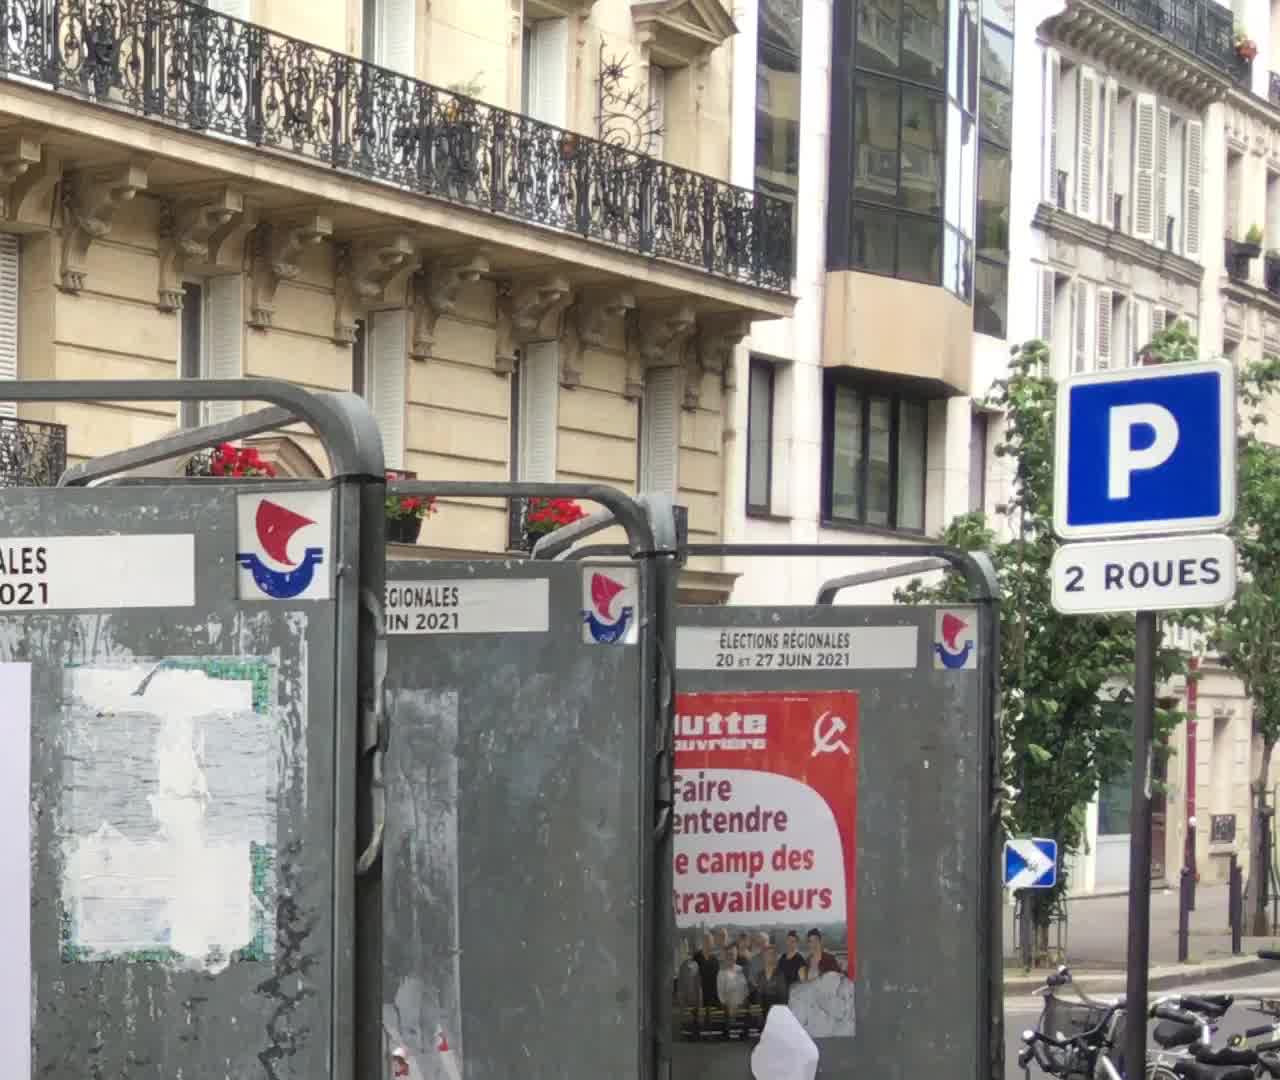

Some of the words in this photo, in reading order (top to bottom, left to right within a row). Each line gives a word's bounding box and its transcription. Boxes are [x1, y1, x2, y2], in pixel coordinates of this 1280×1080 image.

[1108, 403, 1179, 500] P
[1064, 566, 1084, 592] 2
[1104, 558, 1220, 590] ROUES
[384, 587, 458, 608] GIONALES
[385, 613, 408, 630] IN
[416, 613, 459, 630] 2021
[720, 631, 778, 649] ÉLECTIONS
[784, 630, 850, 648] RÉGIONALES
[716, 653, 734, 667] 20
[738, 658, 750, 666] ET
[755, 654, 773, 666] 27
[778, 653, 812, 666] JUIN
[817, 653, 850, 666] 2021
[675, 852, 688, 873] e
[696, 851, 764, 878] camp
[772, 844, 814, 870] des
